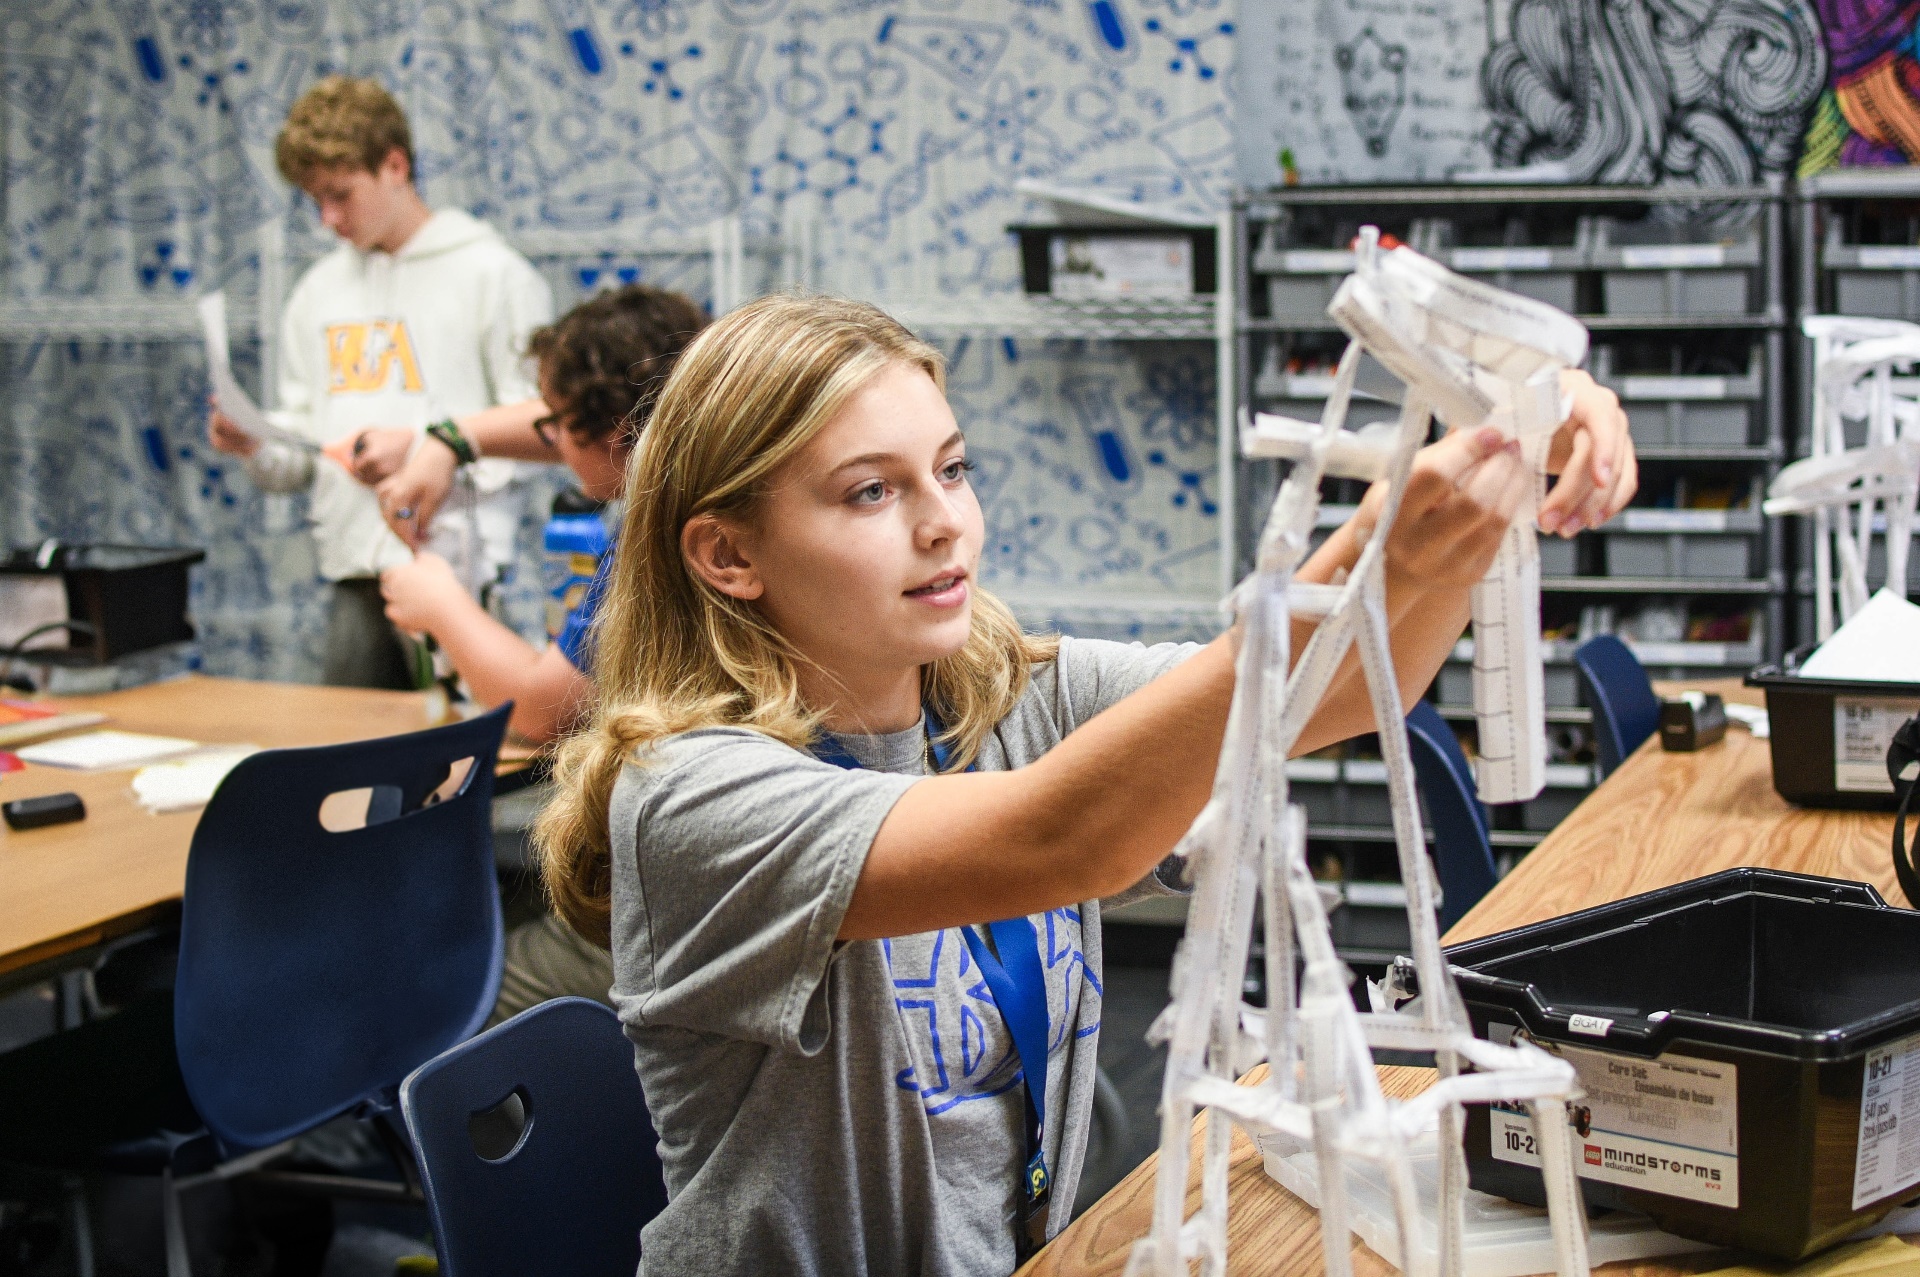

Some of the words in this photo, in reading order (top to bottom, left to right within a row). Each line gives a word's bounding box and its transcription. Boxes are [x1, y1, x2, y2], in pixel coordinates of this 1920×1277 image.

[1608, 1061, 1630, 1076] Core
[1632, 1065, 1648, 1080] Set
[1869, 1054, 1892, 1081] 10-21
[1604, 1147, 1721, 1181] mindstorms
[1604, 1161, 1647, 1176] education
